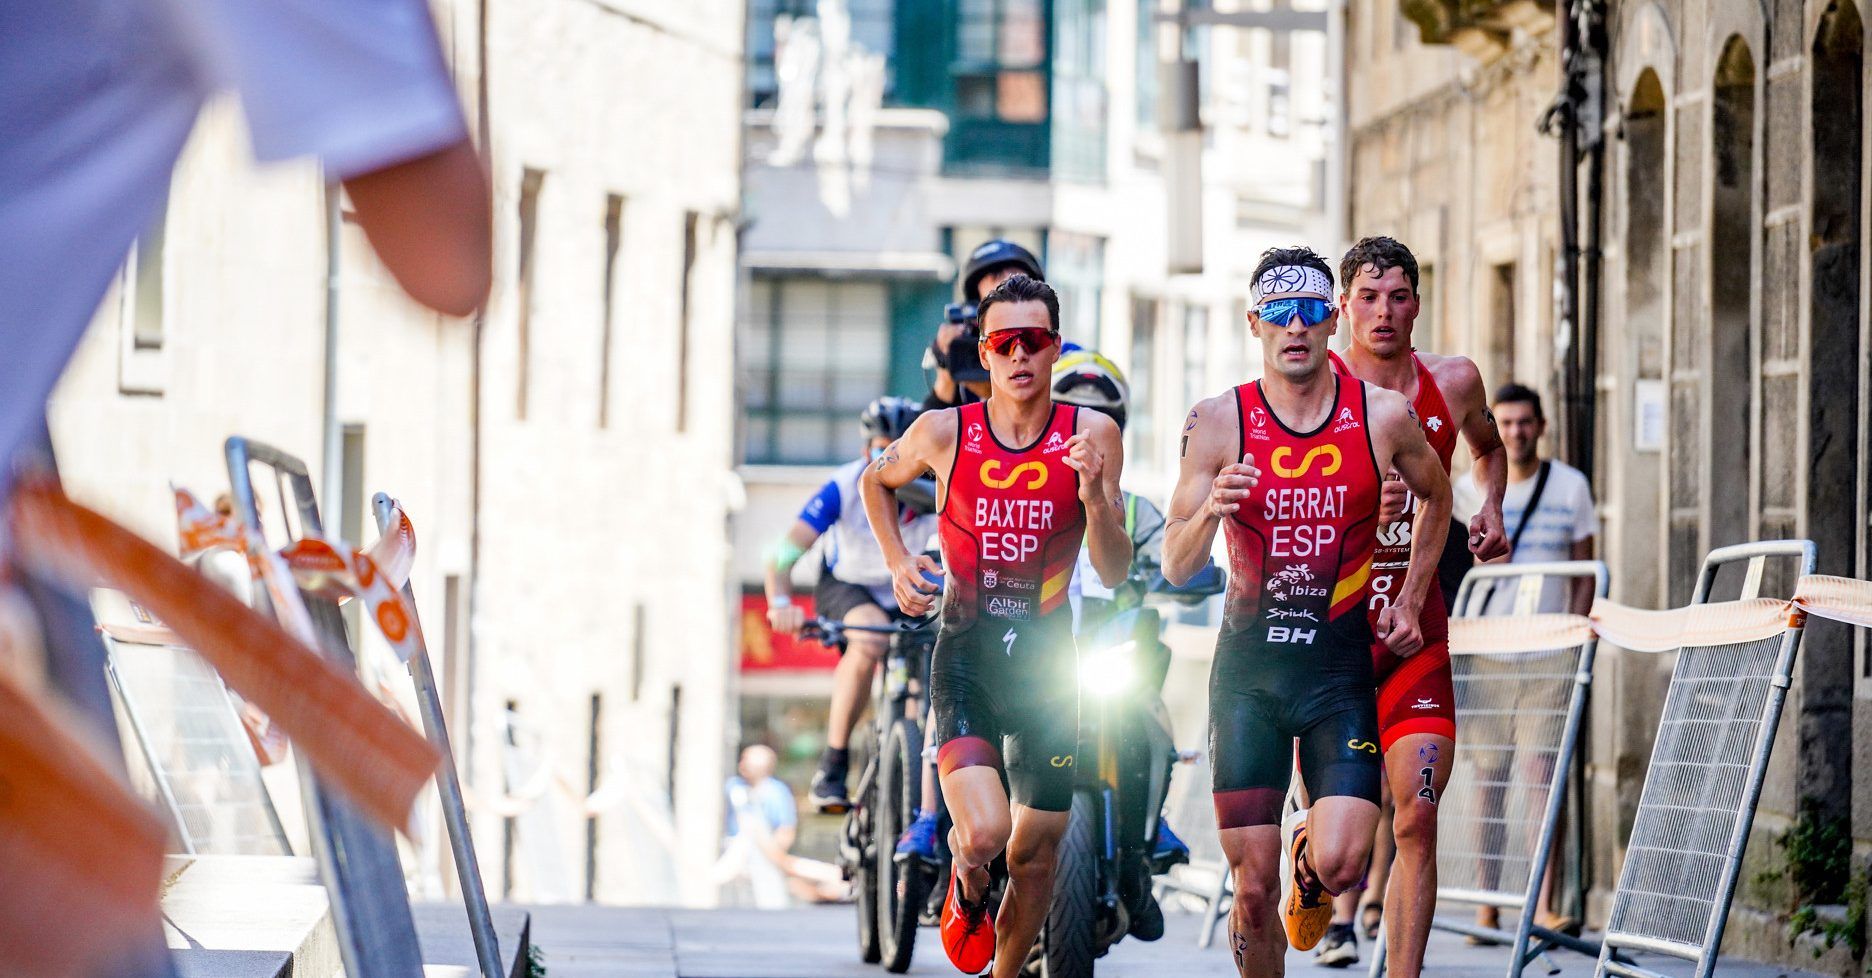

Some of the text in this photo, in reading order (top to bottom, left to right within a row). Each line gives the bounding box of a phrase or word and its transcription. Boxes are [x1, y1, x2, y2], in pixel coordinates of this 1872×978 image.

[1263, 485, 1348, 521] SERRAT
[975, 497, 1054, 530] BAXTER
[981, 532, 1039, 562] ESP
[1270, 525, 1336, 557] ESP
[1006, 580, 1035, 590] Ceuta
[1290, 585, 1328, 597] Ibiza
[989, 605, 1028, 616] Garden
[990, 597, 1029, 609] Albir
[1266, 607, 1319, 623] Spiuk
[1266, 626, 1317, 645] BH
